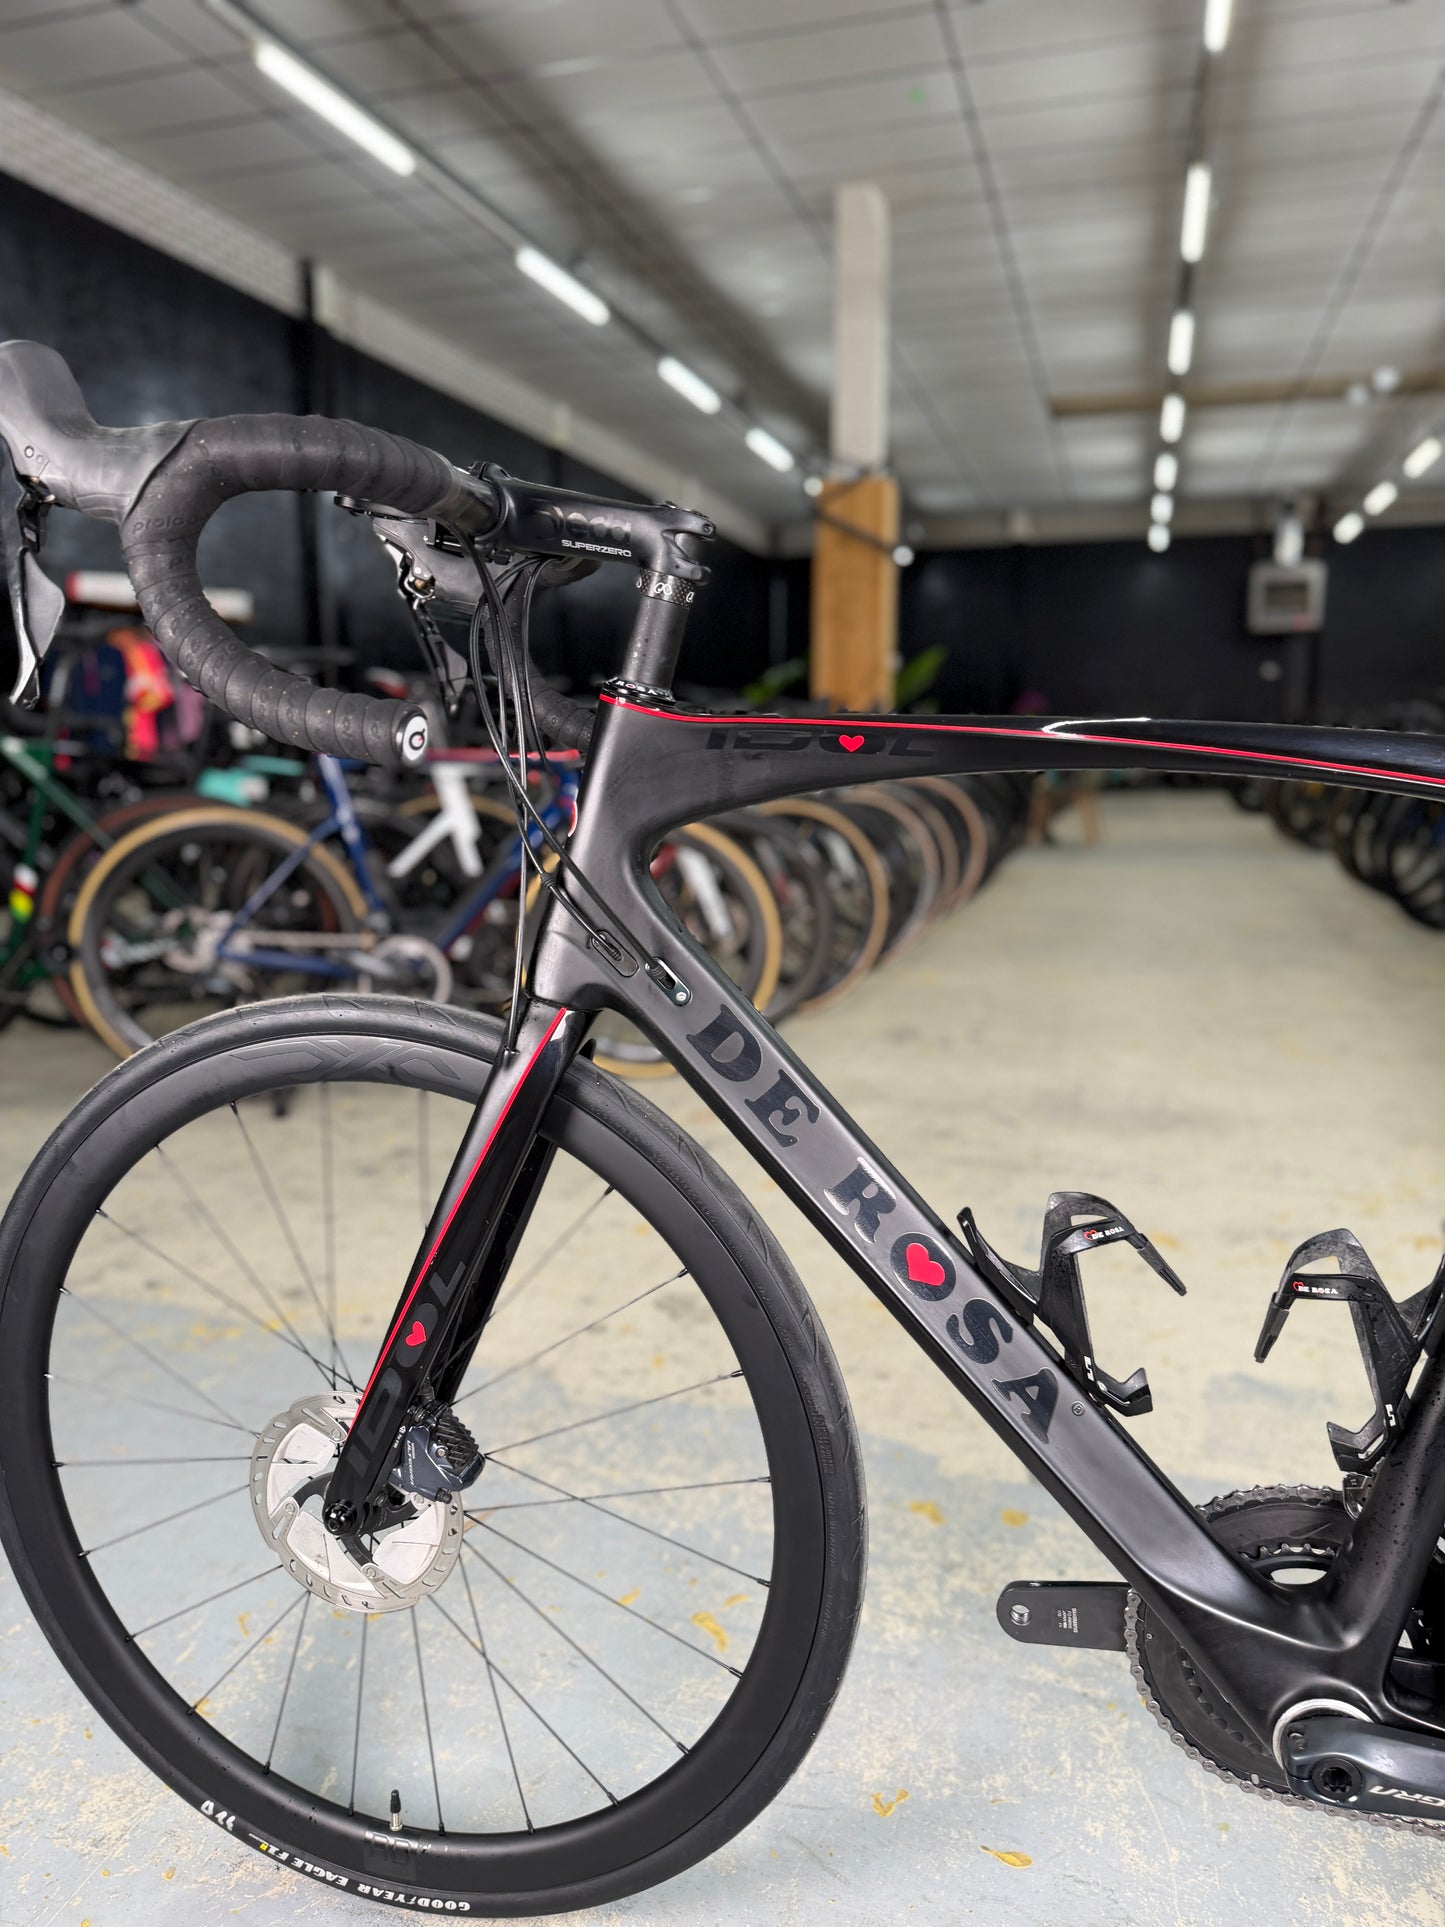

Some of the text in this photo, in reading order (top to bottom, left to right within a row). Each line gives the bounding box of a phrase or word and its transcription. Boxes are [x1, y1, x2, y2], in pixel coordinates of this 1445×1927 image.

[561, 538, 632, 558] SUPERZERO
[686, 1004, 1060, 1444] DE ROSA
[1368, 1785, 1445, 1808] GRA
[291, 1856, 351, 1887] EAGLE
[357, 1882, 471, 1912] GOODYEAR
